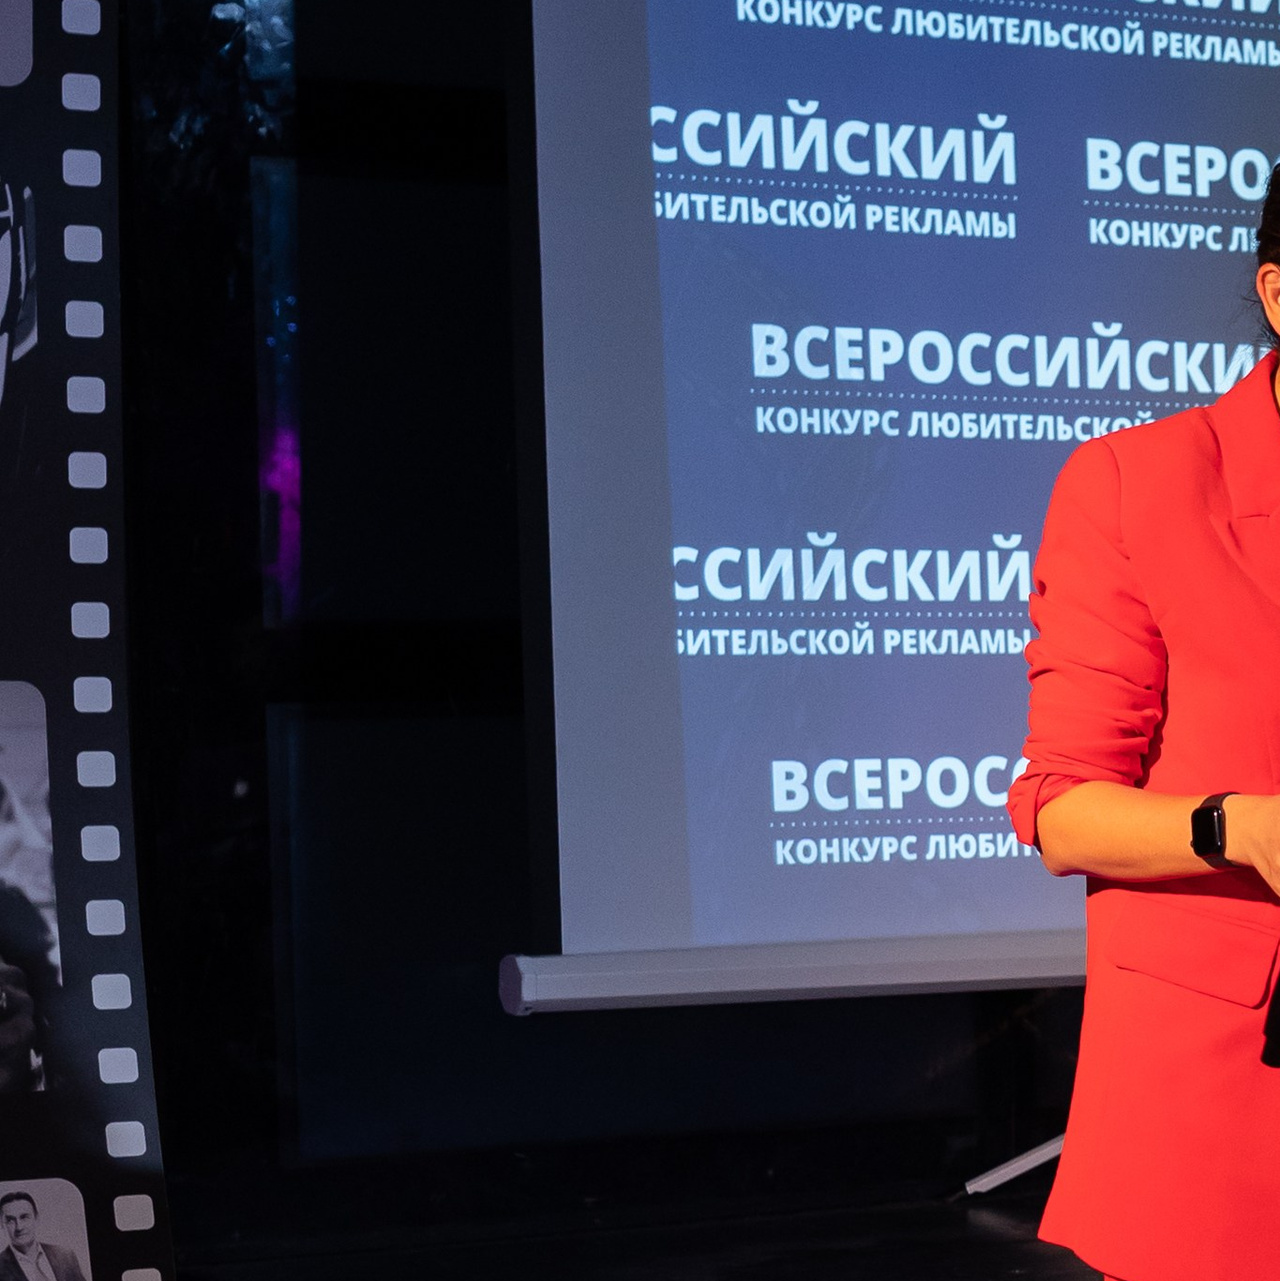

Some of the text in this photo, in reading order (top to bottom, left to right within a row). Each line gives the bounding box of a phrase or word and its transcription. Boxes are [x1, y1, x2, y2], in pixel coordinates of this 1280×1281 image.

[890, 8, 1145, 56] ЛЮБИТЕЛЬСКОЙ
[865, 204, 1016, 239] РЕКЛАМЫ
[1089, 218, 1223, 252] КОНКУРС
[751, 322, 1271, 394] ВСЕРОССИЙСКИ
[756, 406, 900, 437] КОНКУРС
[883, 628, 1031, 656] РЕКЛАМЫ
[772, 755, 1031, 812] ВСЕРОС
[776, 835, 917, 865] КОНКУРС
